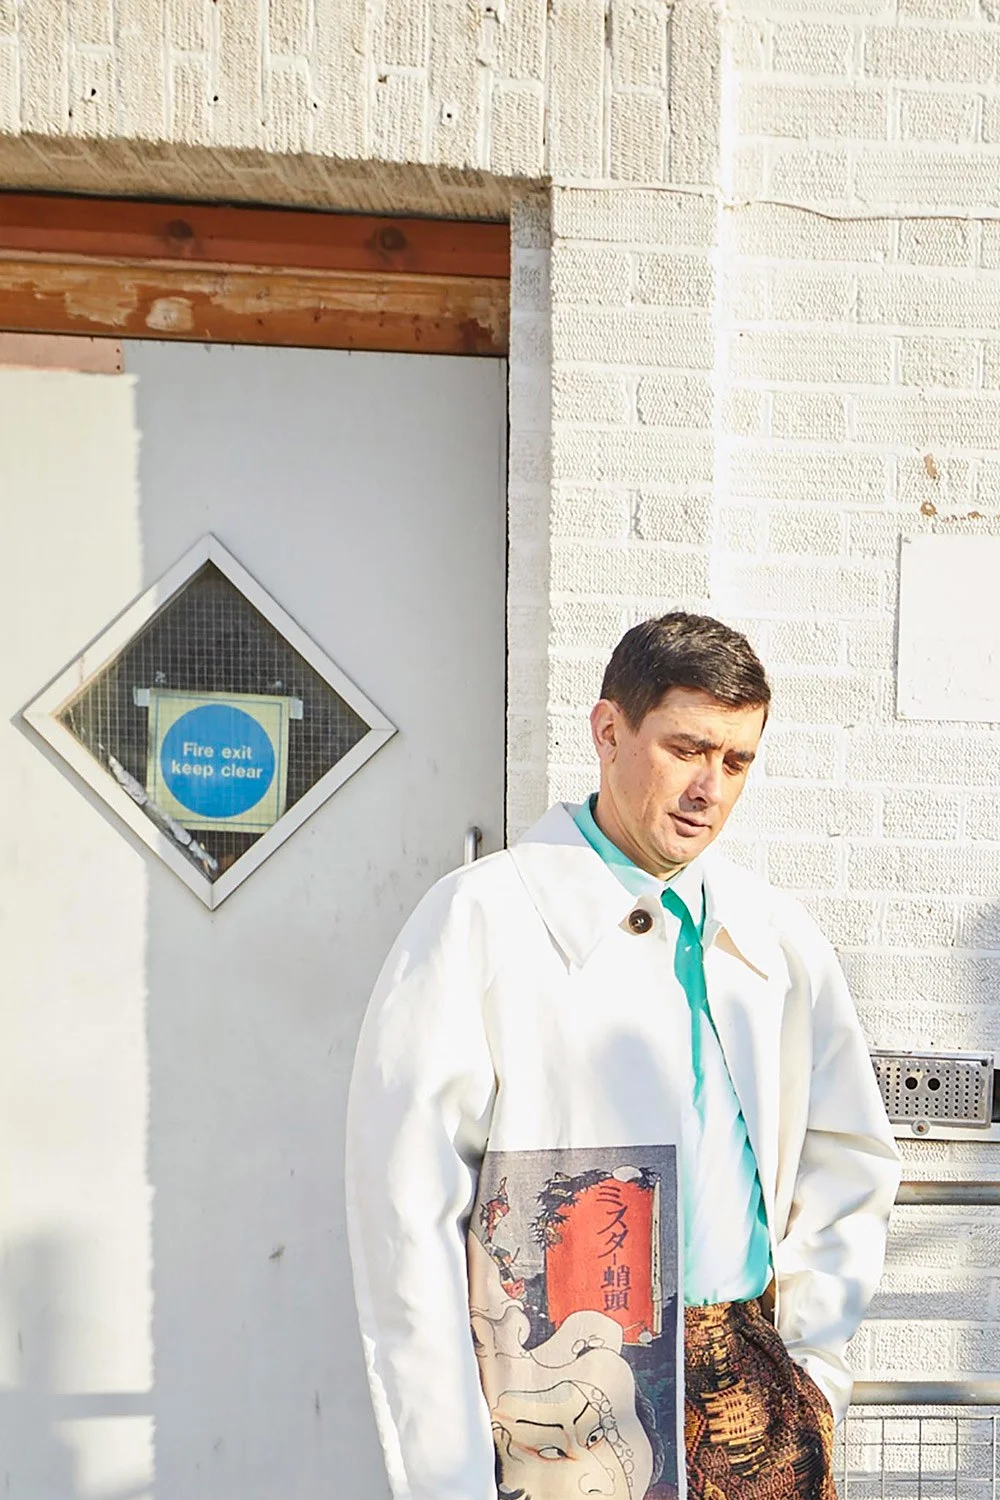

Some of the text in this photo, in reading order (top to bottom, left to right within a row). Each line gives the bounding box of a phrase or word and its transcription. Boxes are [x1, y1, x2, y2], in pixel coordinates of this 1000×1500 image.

[183, 742, 252, 760] Fire exit
[171, 760, 263, 779] keep clear
